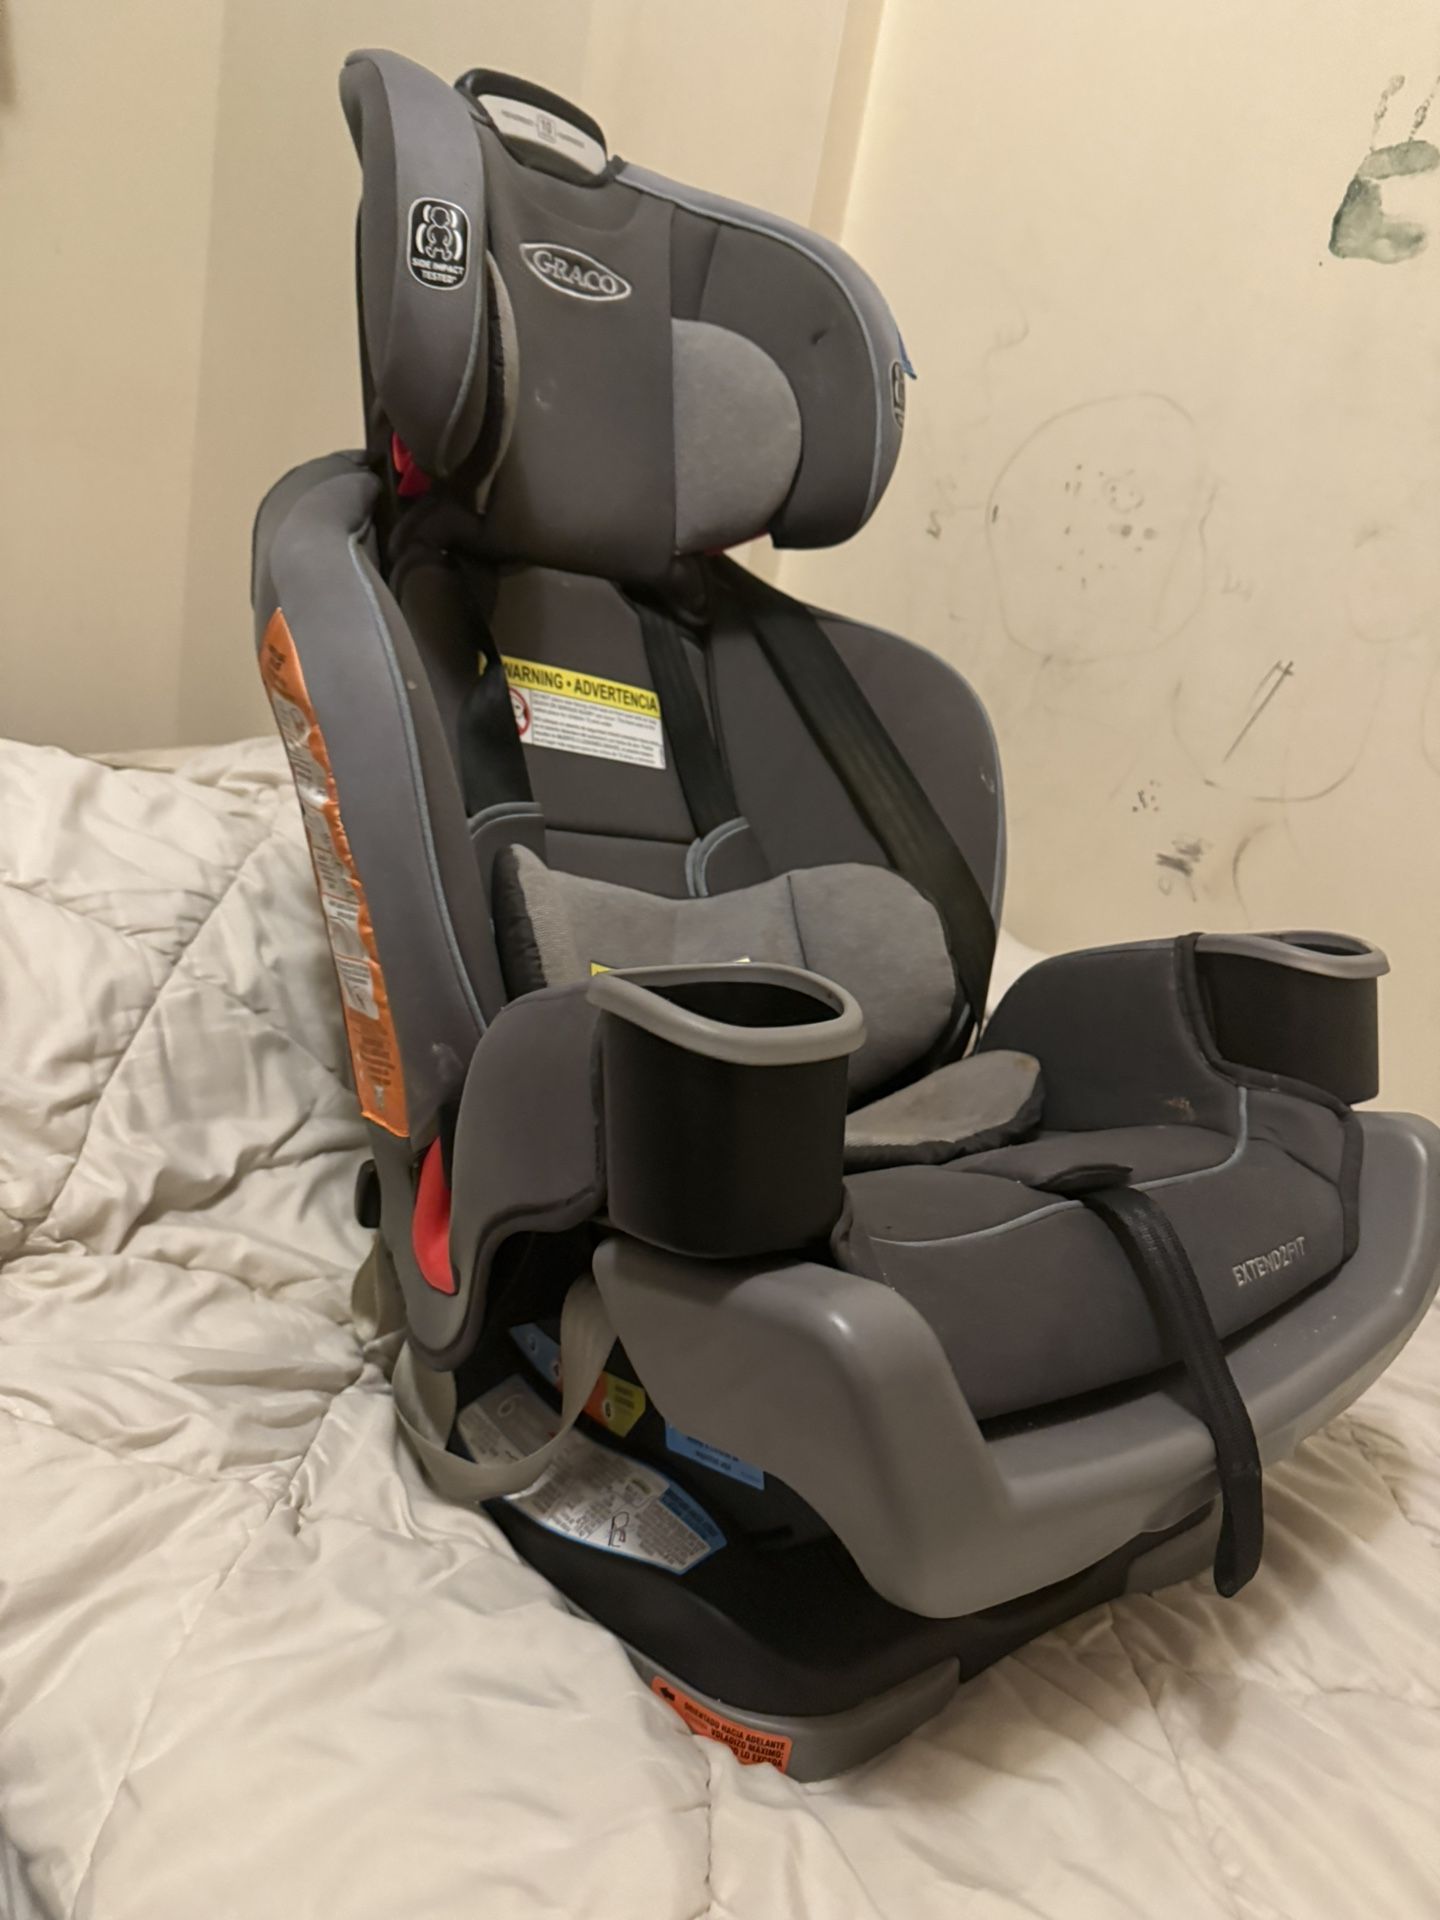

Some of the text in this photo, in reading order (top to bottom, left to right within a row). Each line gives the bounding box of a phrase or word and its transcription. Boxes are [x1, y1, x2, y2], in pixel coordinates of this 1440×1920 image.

[412, 257, 465, 275] SIDE IMPACT
[532, 249, 619, 294] GRACO
[503, 661, 659, 713] WARNING ADVERTENCIA
[1232, 1236, 1305, 1287] EXTEND2FIT
[745, 1734, 785, 1750] ADELANTE
